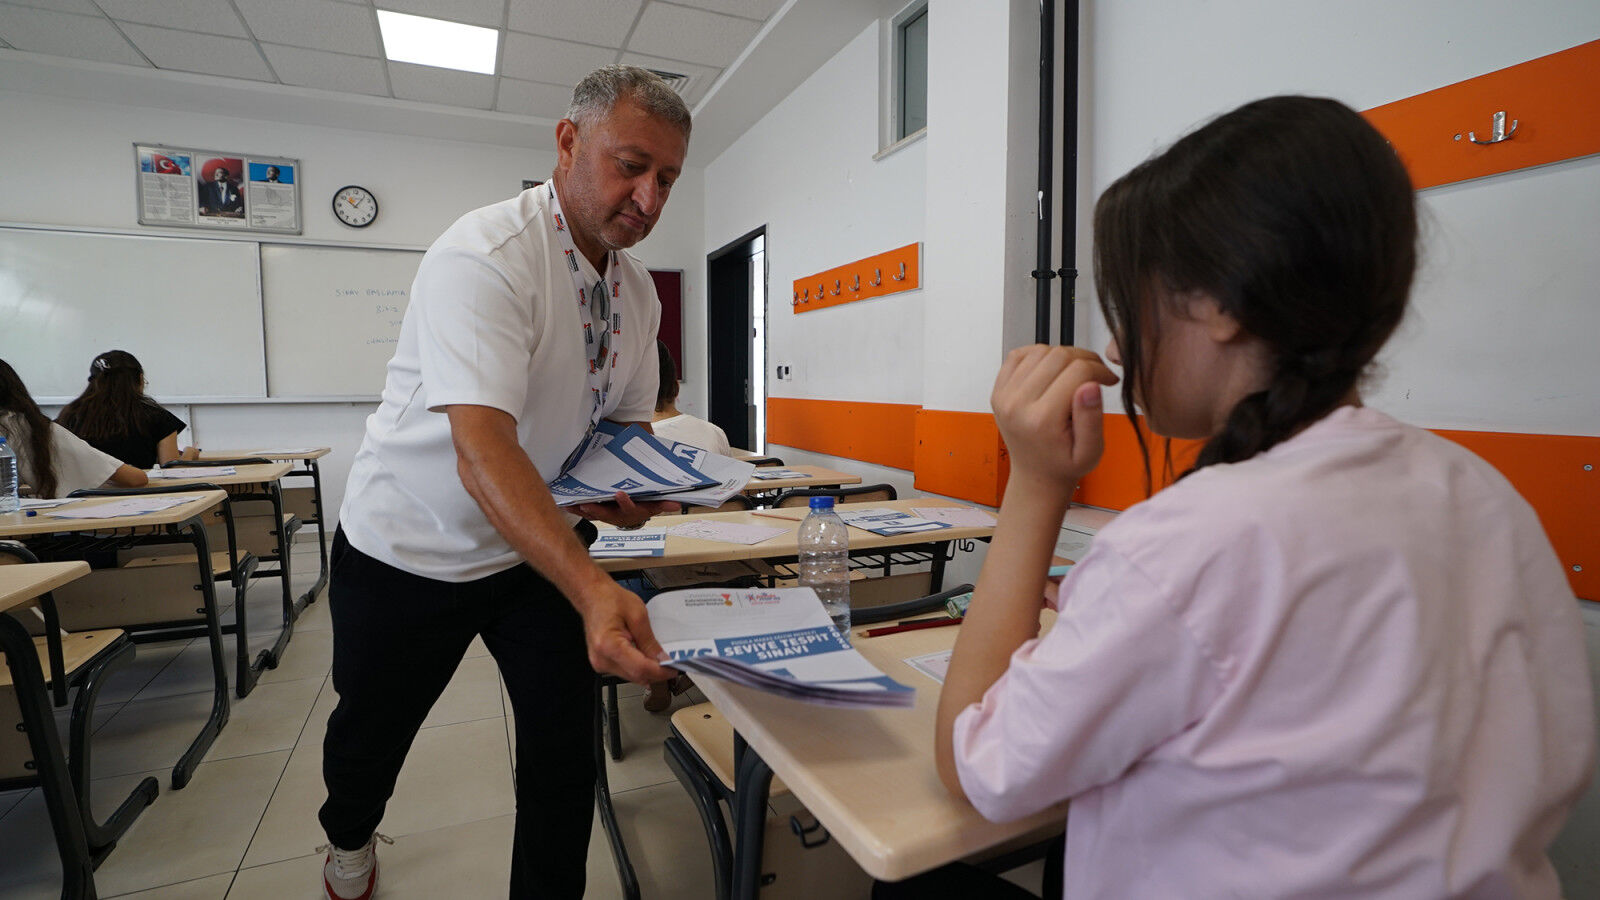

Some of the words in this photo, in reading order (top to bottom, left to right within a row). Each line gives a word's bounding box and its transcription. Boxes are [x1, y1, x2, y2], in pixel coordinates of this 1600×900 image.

[723, 640, 778, 657] SEVİYE
[778, 632, 829, 648] TESPİT
[756, 646, 810, 660] SINAVI
